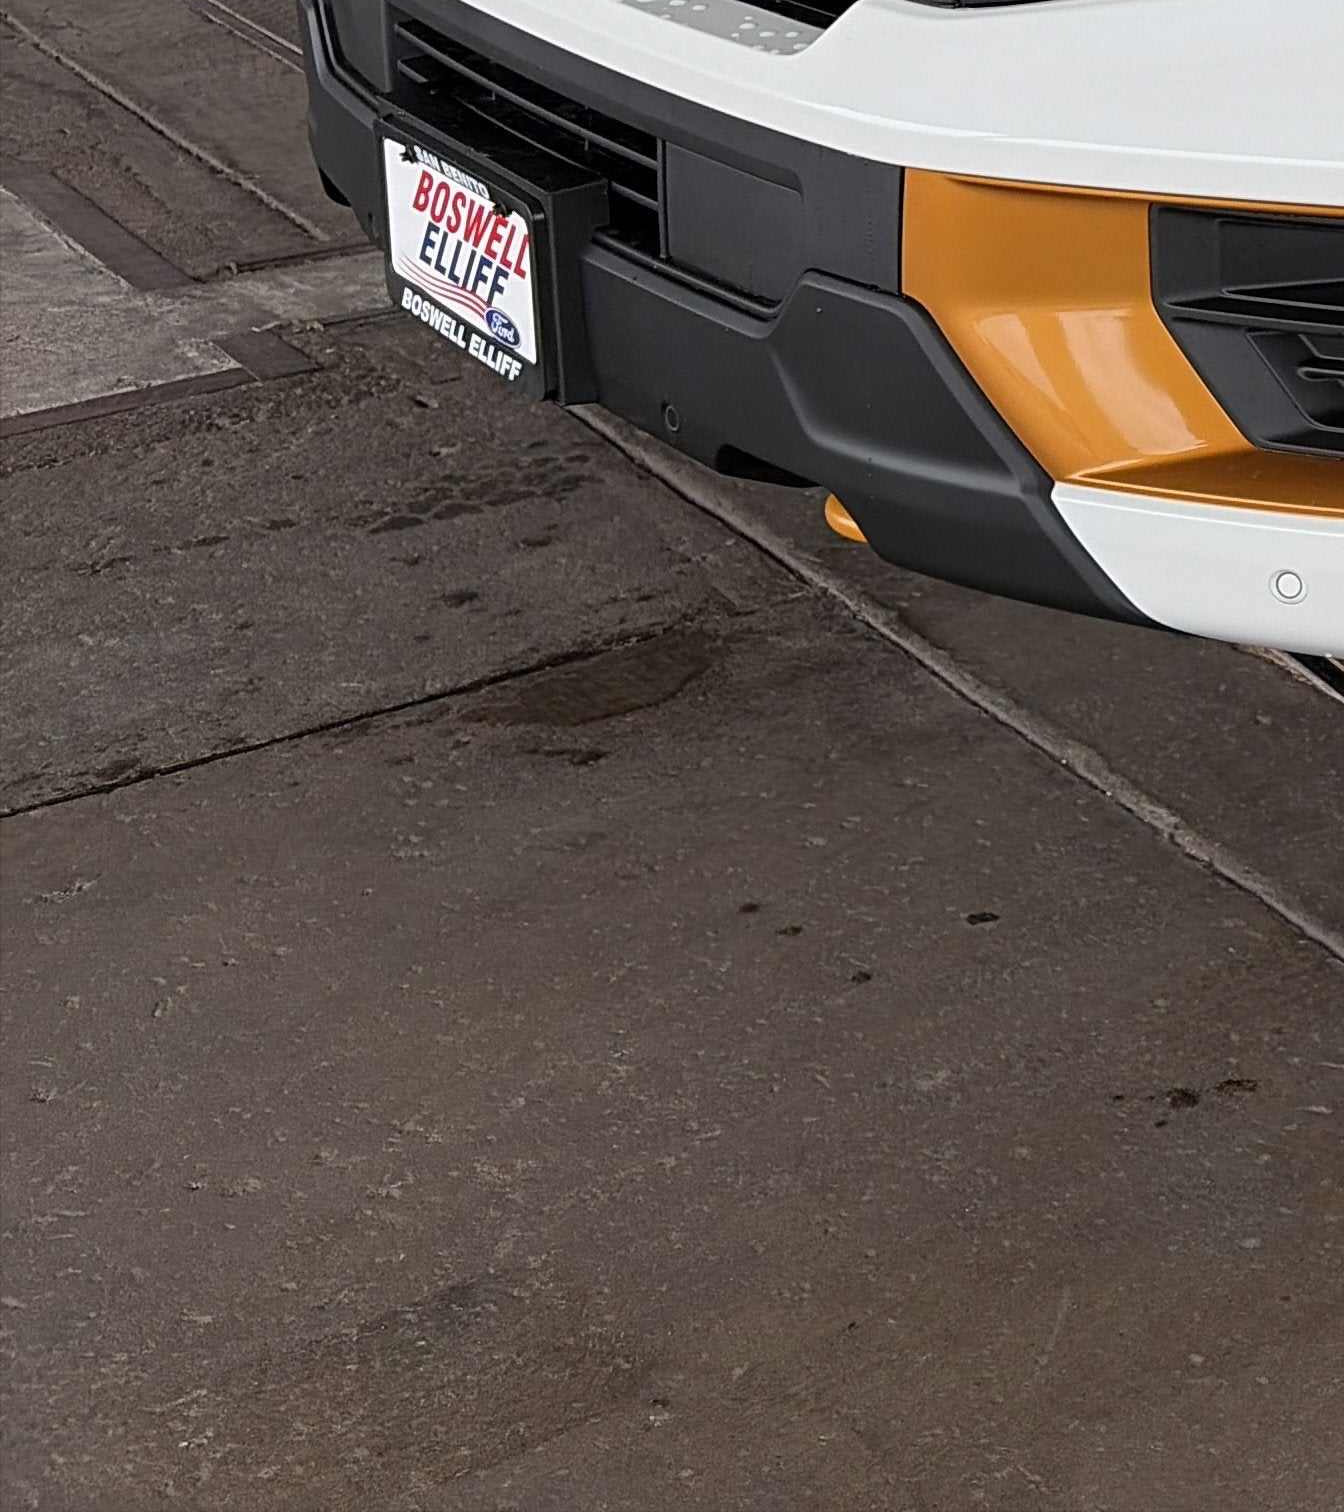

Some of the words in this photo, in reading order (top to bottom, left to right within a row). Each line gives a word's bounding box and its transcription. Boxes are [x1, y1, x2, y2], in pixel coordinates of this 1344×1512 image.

[413, 144, 441, 172] SAN
[440, 159, 491, 200] BENITO
[412, 169, 529, 279] BOSWELL
[419, 220, 510, 308] ELLIFF
[401, 286, 466, 349] BOSWELL
[468, 332, 523, 381] ELLIFF
[490, 312, 515, 343] Ford
